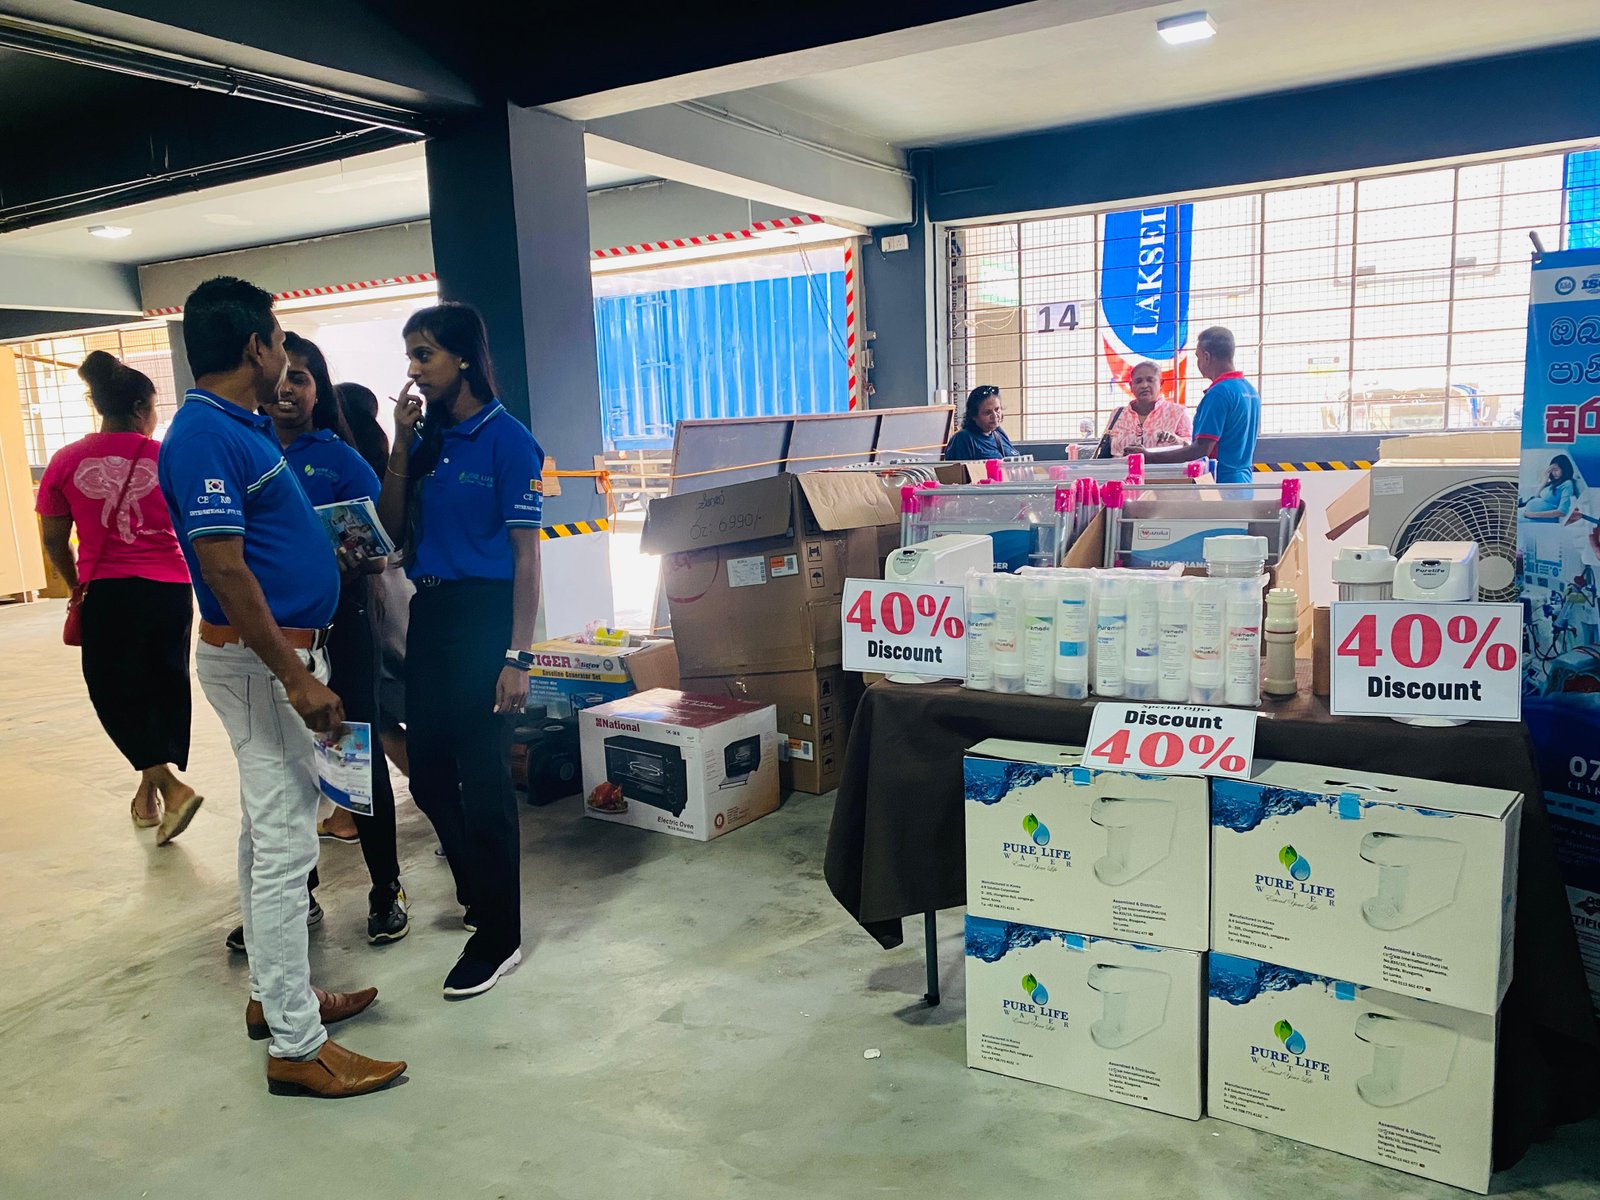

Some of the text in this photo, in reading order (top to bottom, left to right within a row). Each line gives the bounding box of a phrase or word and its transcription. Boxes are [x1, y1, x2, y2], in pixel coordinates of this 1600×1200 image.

[1581, 279, 1600, 290] IS
[1038, 304, 1079, 334] 14
[846, 590, 964, 639] 40%
[867, 640, 943, 664] Discount
[1337, 613, 1517, 671] 40%
[1368, 675, 1482, 702] Discount
[603, 718, 641, 733] National
[1125, 711, 1223, 730] Discount
[1091, 729, 1246, 772] 40%
[657, 816, 694, 830] Electric Oven
[1003, 843, 1072, 860] PURE LIFE
[1004, 853, 1072, 868] WATER
[1255, 874, 1335, 899] PURE LIFE
[1256, 885, 1335, 907] WATER
[1003, 1000, 1069, 1021] PURE LIFE
[1004, 1009, 1069, 1028] WATER
[1250, 1046, 1330, 1073] PURE LIFE
[1251, 1056, 1331, 1081] WATER
